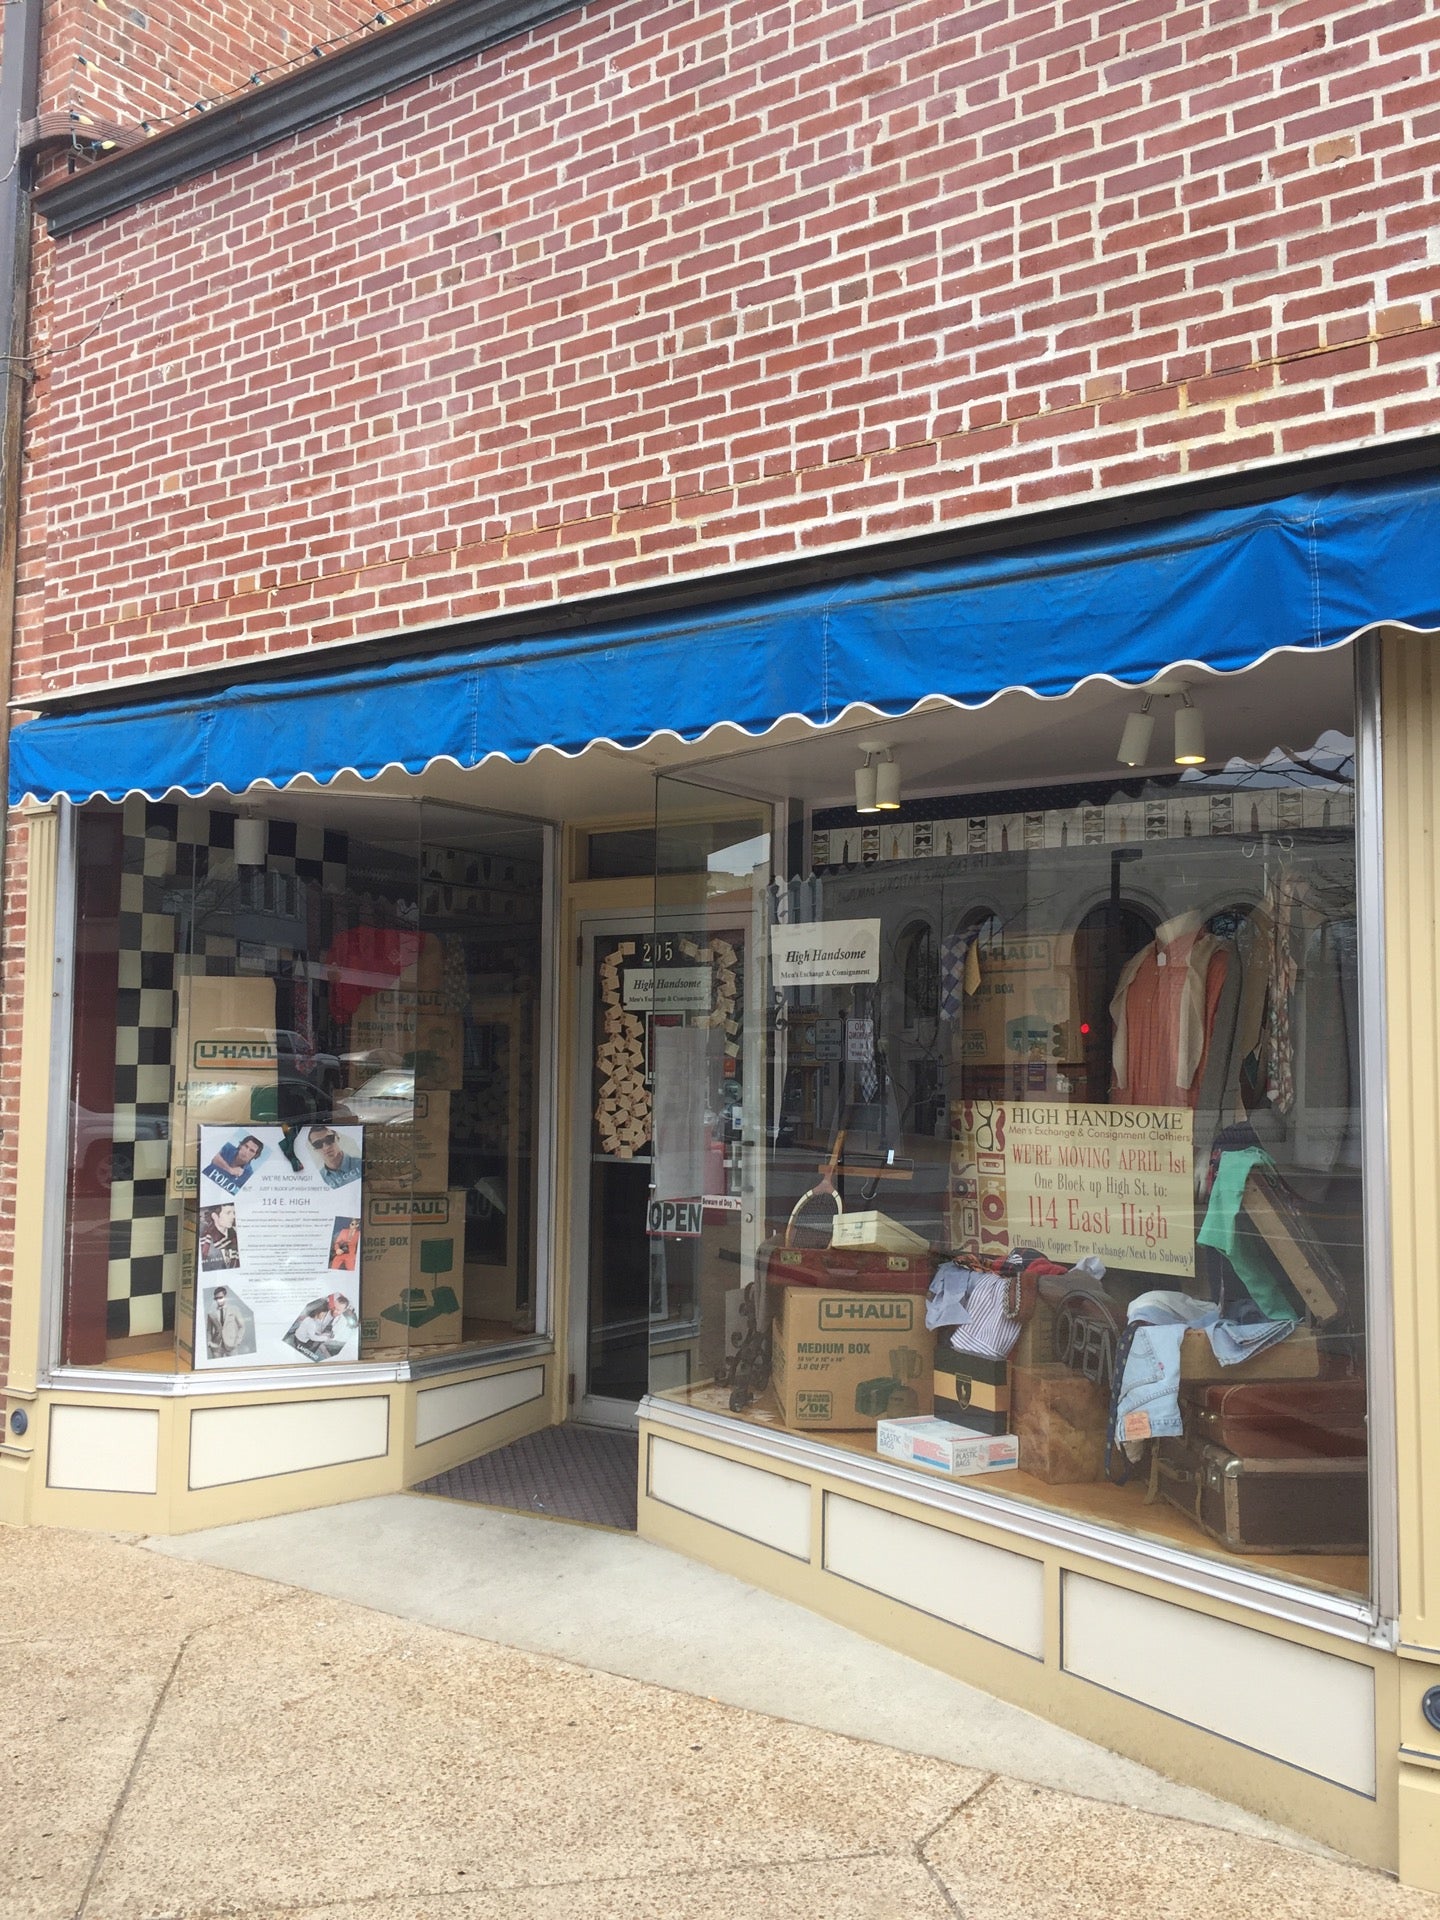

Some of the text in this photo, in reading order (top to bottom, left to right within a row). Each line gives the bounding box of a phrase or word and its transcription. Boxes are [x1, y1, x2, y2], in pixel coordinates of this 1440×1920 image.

[786, 948, 866, 965] High Handsome
[633, 978, 701, 992] High Handsome
[200, 1045, 277, 1059] U-HAUL
[1012, 1107, 1183, 1130] HIGH HANDSOME
[1009, 1126, 1190, 1142] Men's Exchange & Consignment Clothiers
[1012, 1144, 1186, 1174] WE'RE MOVING APRIL 1st
[1034, 1172, 1168, 1199] One Block up High St. to:
[262, 1198, 311, 1206] 114 E. HIGH
[374, 1202, 444, 1215] U-HAUL
[702, 1198, 732, 1208] Beware of Dog
[649, 1202, 701, 1233] OPEN
[1028, 1195, 1168, 1248] 114 East High
[389, 1236, 409, 1246] BOX
[1012, 1234, 1194, 1267] (Formally Copper Tree Exchange/Next to Subway)
[825, 1304, 907, 1319] U-HAUL
[797, 1343, 871, 1354] MEDIUM BOX
[809, 1403, 830, 1413] OK
[880, 1430, 901, 1445] PLASTIC
[880, 1439, 895, 1450] BAGS
[956, 1451, 978, 1460] PLASTIC
[955, 1459, 970, 1467] BAGS
